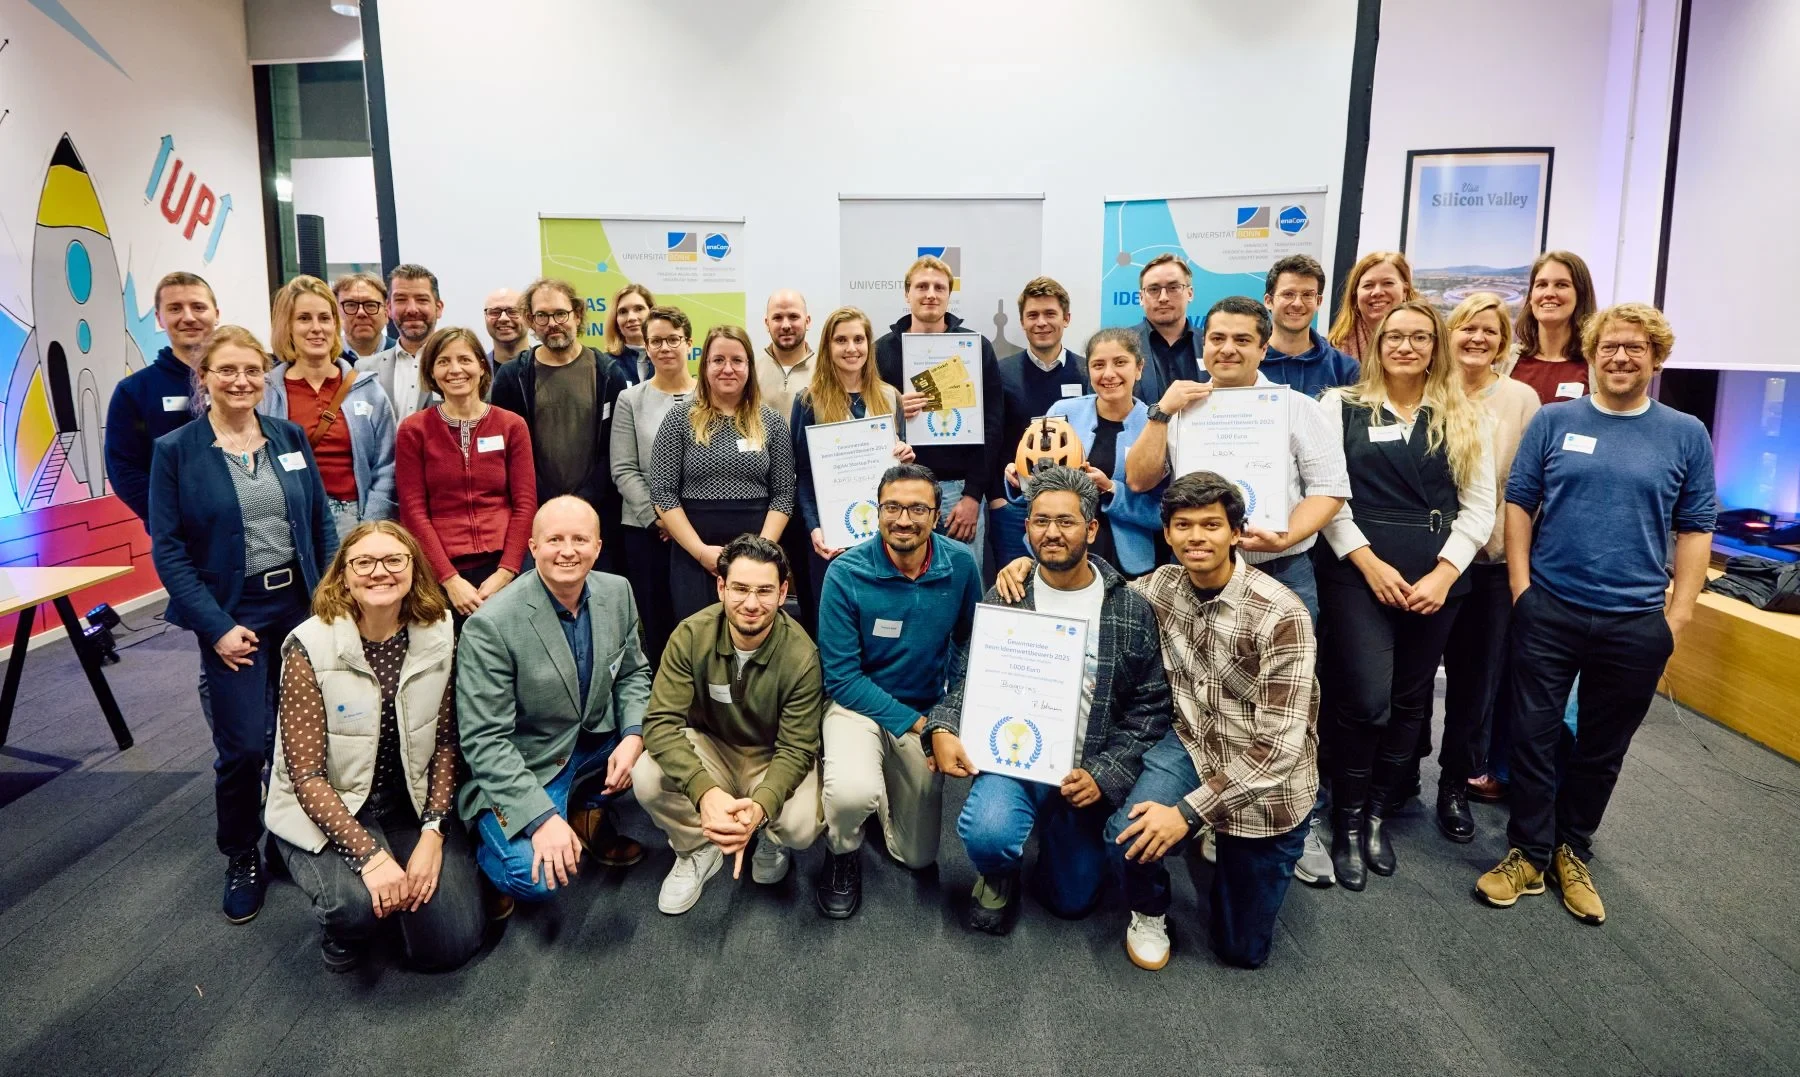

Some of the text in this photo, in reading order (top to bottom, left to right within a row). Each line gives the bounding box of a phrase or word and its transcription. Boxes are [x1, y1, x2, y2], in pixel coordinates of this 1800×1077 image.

[1462, 182, 1480, 193] Visit
[1431, 192, 1528, 208] Silicon Valley
[1007, 638, 1049, 650] Gewinneridee
[1000, 645, 1054, 659] Ideenwettbewerb
[1054, 653, 1070, 662] 2025
[1026, 666, 1041, 674] Euro
